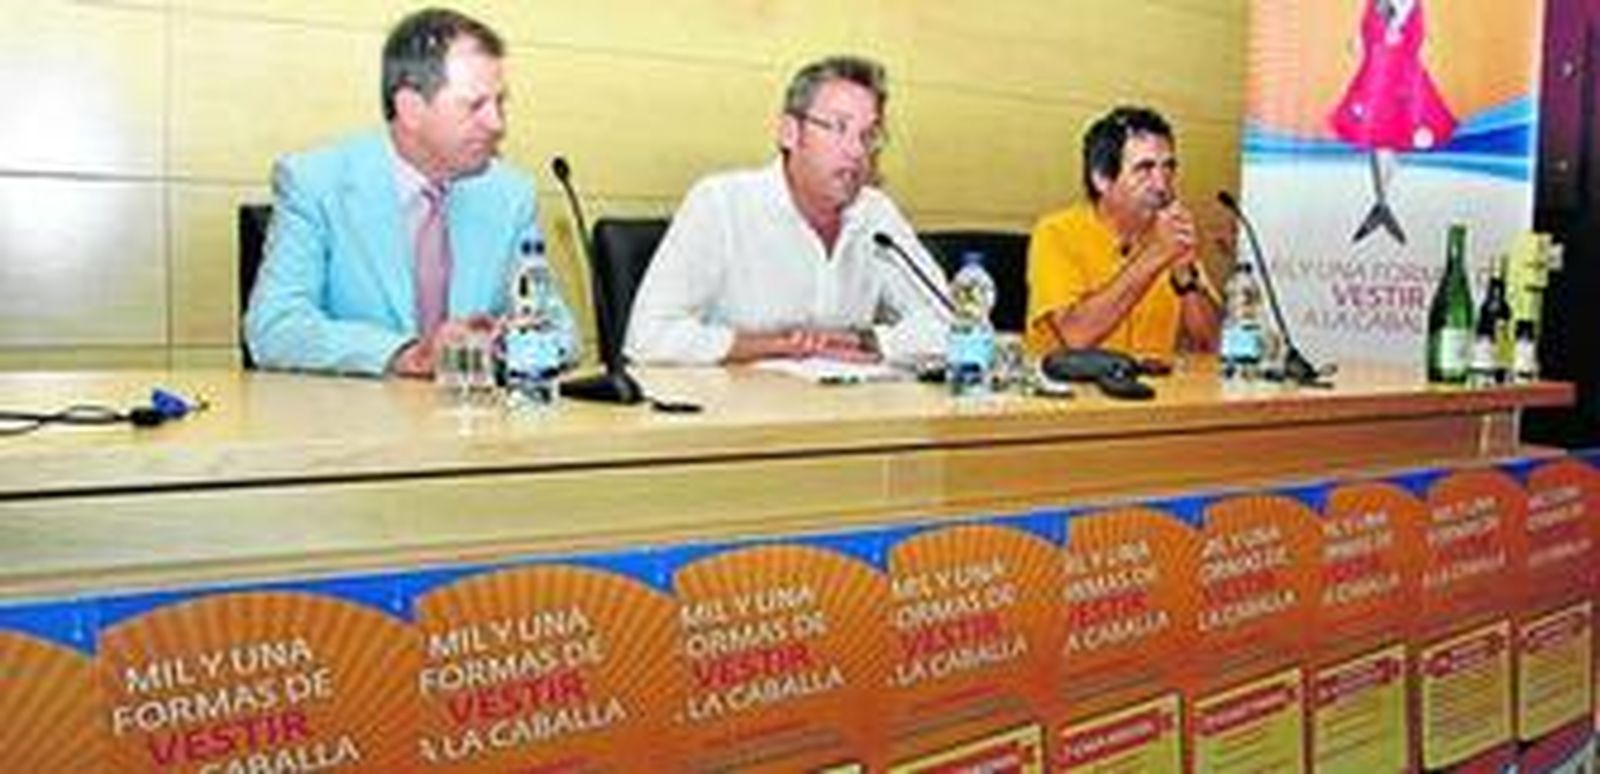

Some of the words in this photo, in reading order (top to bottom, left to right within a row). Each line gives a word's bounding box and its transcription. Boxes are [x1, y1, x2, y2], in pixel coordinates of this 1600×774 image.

[1331, 279, 1426, 310] VESTIR
[755, 582, 817, 613] UNA
[426, 627, 489, 662] MIL
[490, 619, 515, 643] Y
[518, 604, 592, 639] UNA
[792, 610, 830, 641] DE
[124, 660, 196, 695] MIL
[198, 650, 224, 680] Y
[229, 636, 314, 675] UNA
[417, 644, 558, 697] FORMAS
[563, 635, 608, 666] DE
[692, 641, 814, 690] VESTIR
[726, 665, 847, 712] CABALLA
[111, 682, 281, 738] FORMAS
[283, 667, 334, 703] DE
[446, 669, 592, 724] VESTIR
[149, 713, 311, 768] VESTIR
[443, 728, 485, 762] LA
[488, 697, 628, 749] CABALLA
